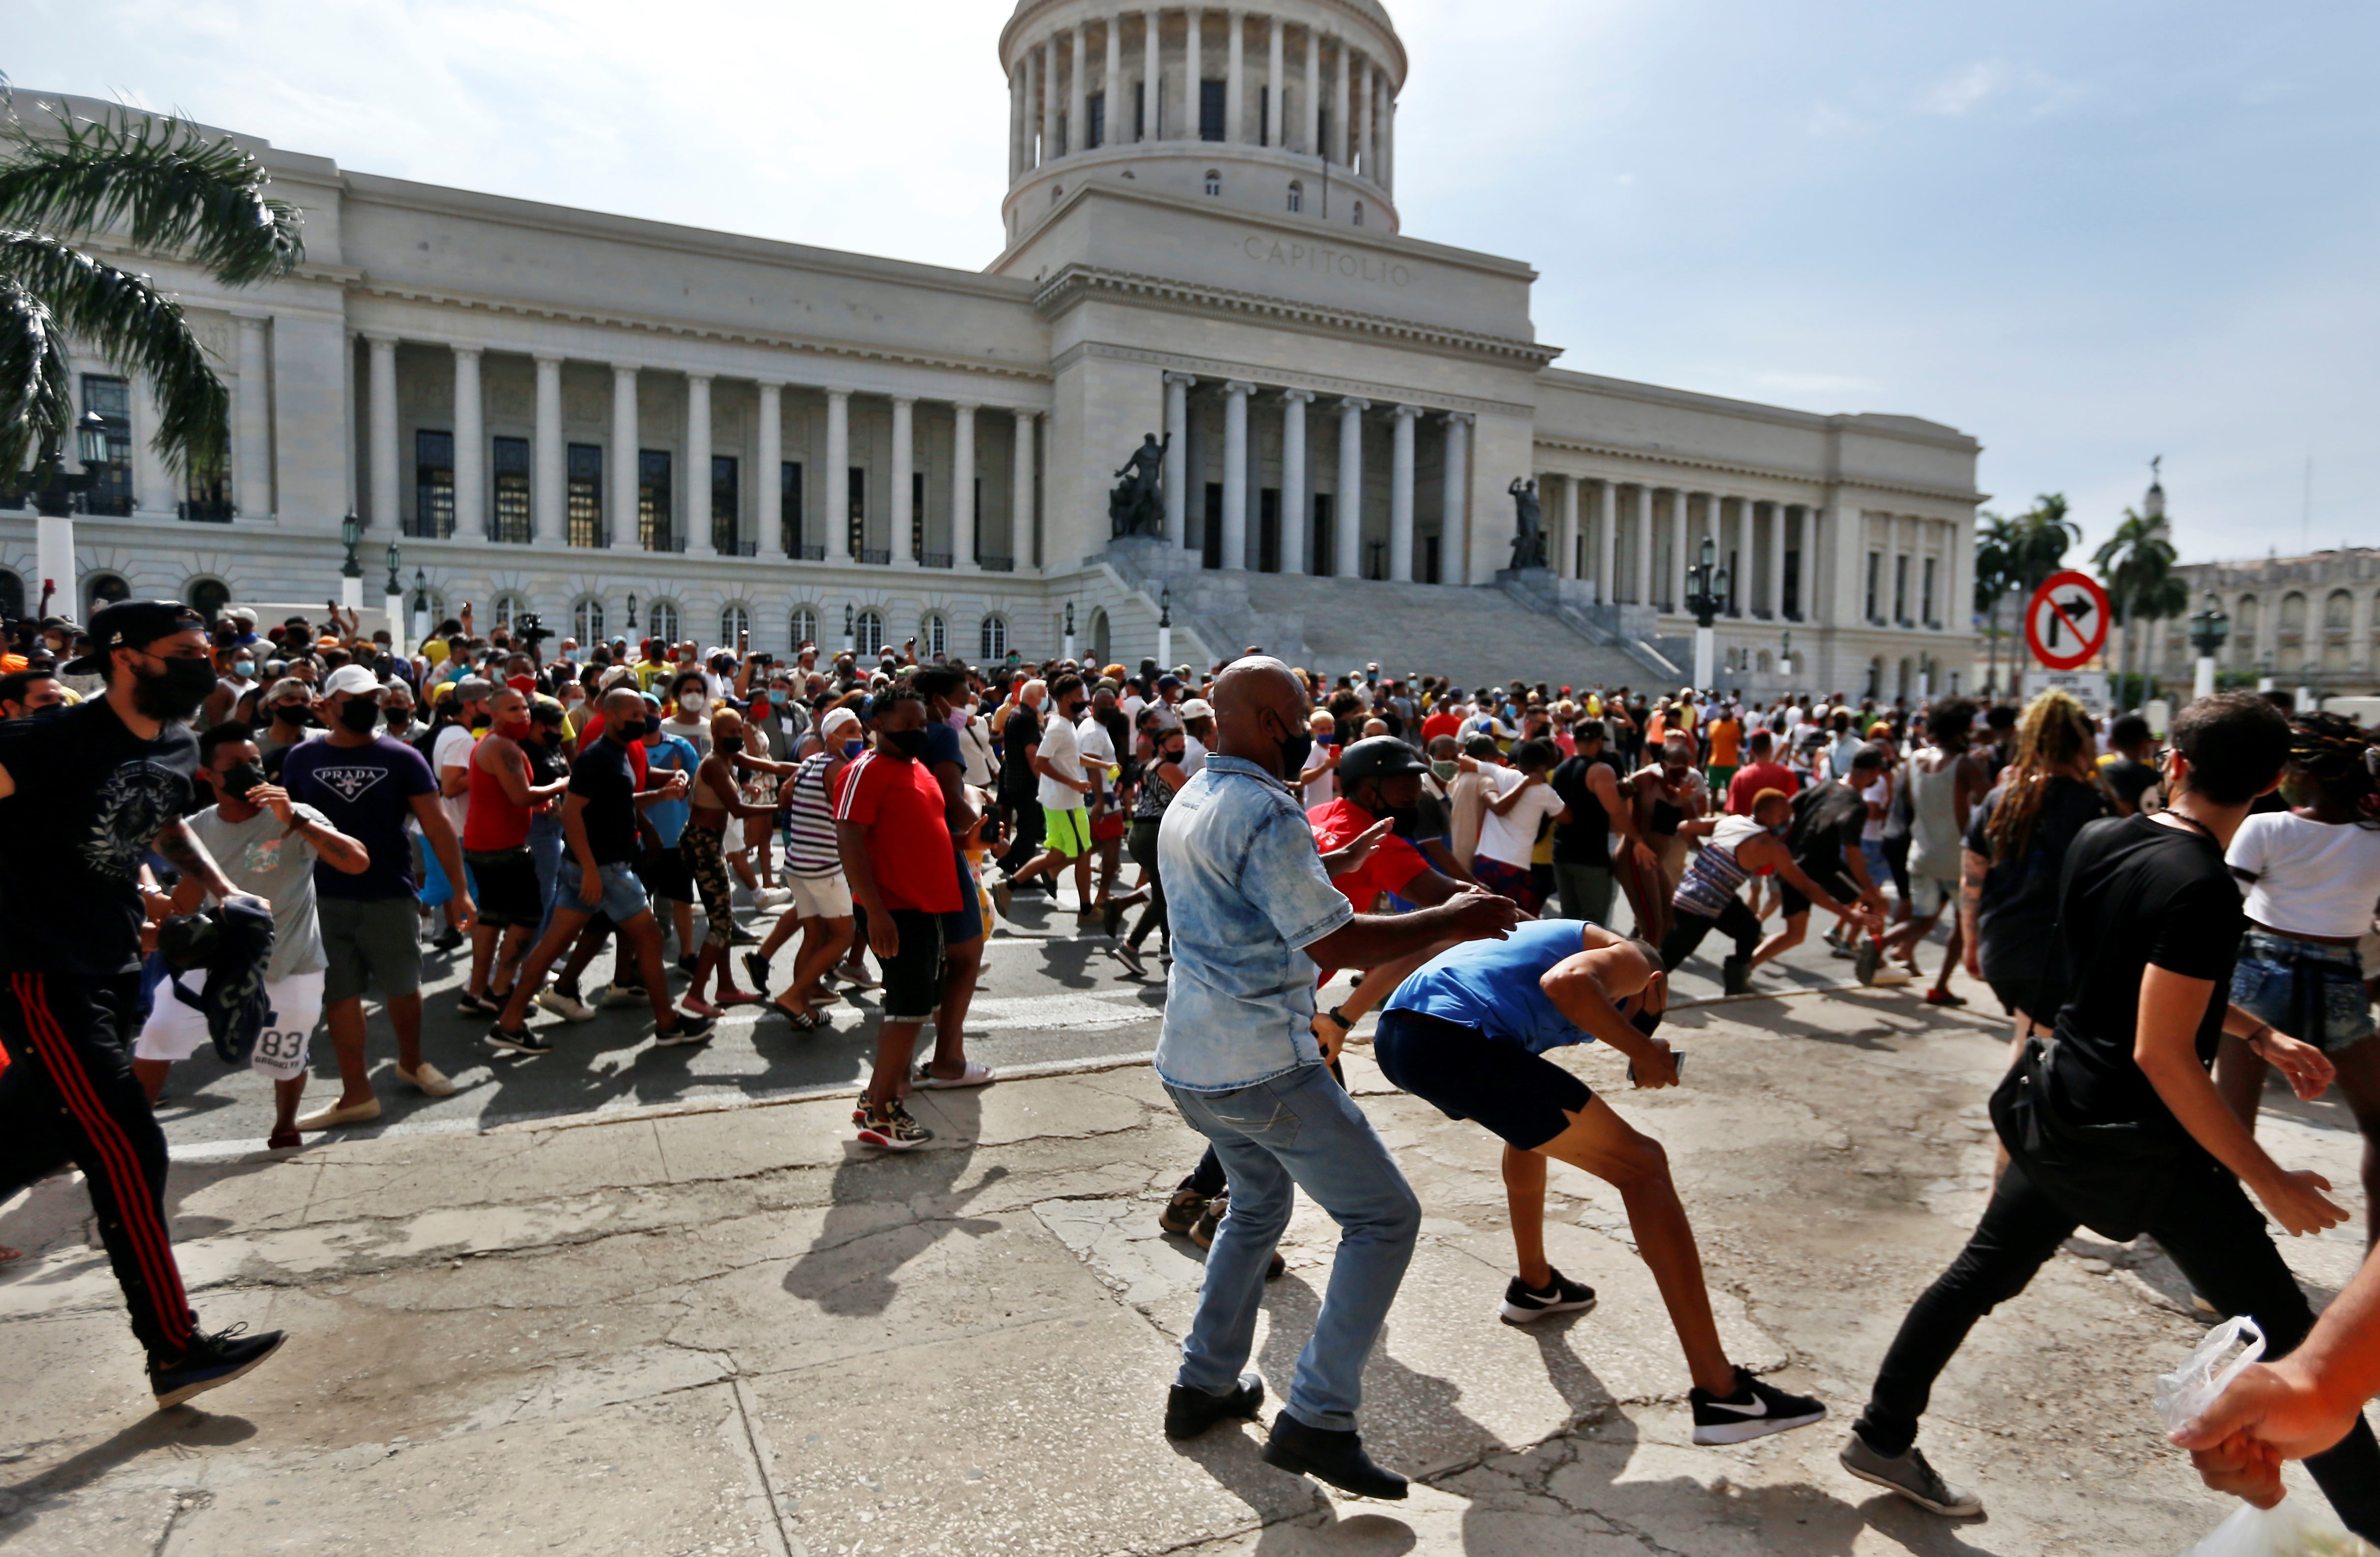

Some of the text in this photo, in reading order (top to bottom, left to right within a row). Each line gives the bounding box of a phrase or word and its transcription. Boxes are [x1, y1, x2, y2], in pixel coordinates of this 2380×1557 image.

[1244, 236, 1410, 287] CAPITOLIO
[322, 770, 376, 779] PRADA
[262, 1031, 303, 1059] 83
